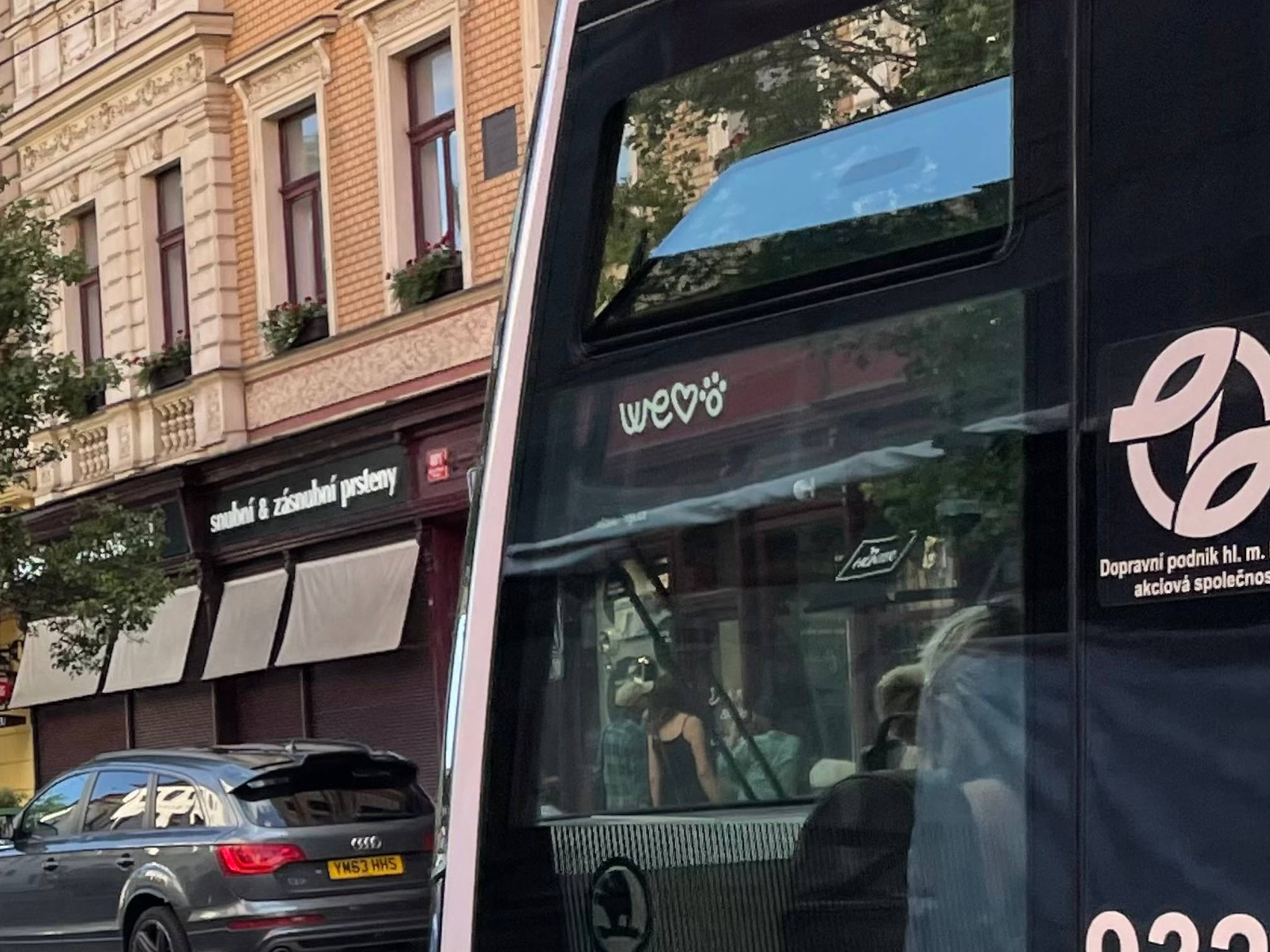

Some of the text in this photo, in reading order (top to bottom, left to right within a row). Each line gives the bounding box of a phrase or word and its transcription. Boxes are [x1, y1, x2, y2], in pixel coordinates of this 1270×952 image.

[258, 498, 269, 520] &
[273, 474, 337, 516] zásnubní
[340, 466, 398, 508] prsteny
[1100, 552, 1164, 579] Dopravní
[1167, 546, 1219, 574] podnik
[1223, 544, 1241, 564] hl.
[1246, 545, 1265, 561] m.
[1134, 575, 1190, 598] akciová
